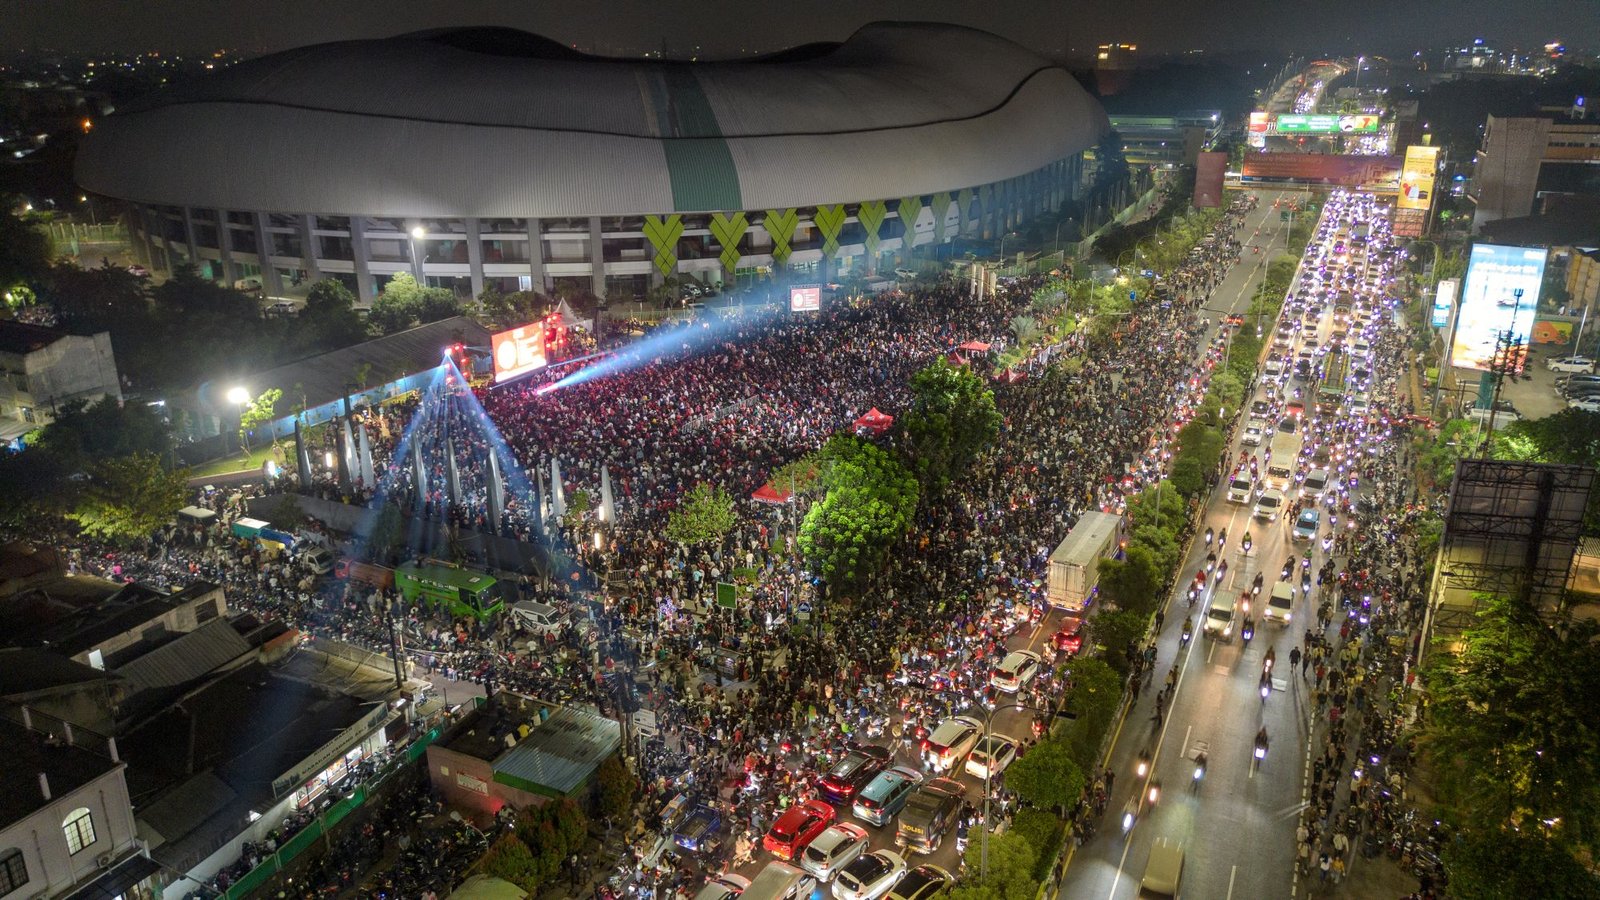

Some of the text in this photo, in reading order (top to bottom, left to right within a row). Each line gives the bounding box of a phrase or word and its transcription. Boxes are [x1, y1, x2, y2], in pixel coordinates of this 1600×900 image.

[313, 727, 353, 756] RUMAH MAKAN
[331, 737, 354, 753] PADANG
[902, 824, 924, 835] POLISI
